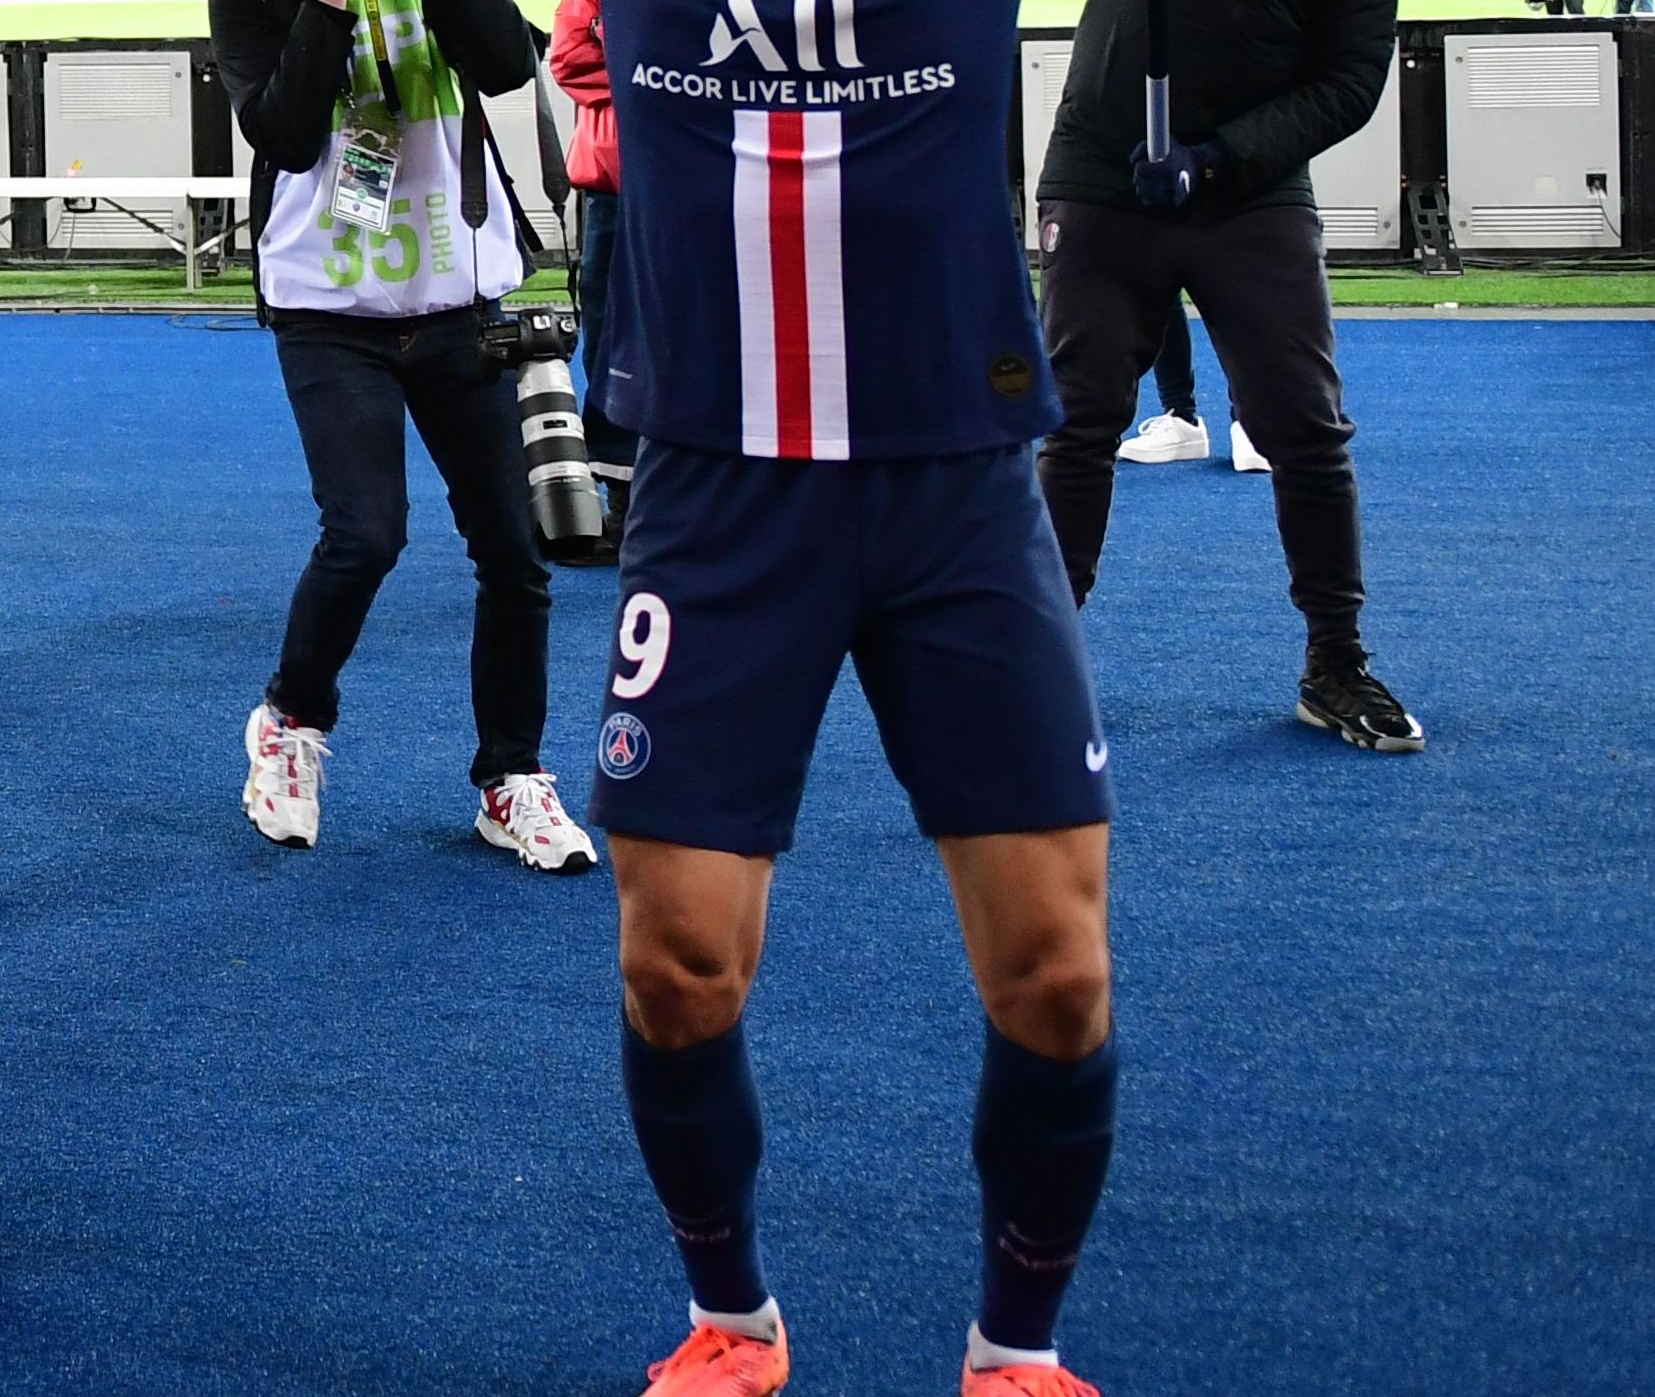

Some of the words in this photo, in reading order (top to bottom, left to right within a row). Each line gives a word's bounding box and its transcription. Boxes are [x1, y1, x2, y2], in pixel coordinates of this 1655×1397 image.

[632, 63, 723, 100] ACCOR
[731, 79, 798, 104] LIVE
[806, 63, 956, 104] LIMITLESS
[316, 197, 421, 288] 35
[425, 192, 456, 276] PHOTO
[611, 591, 671, 700] 9
[608, 715, 643, 738] PARIS
